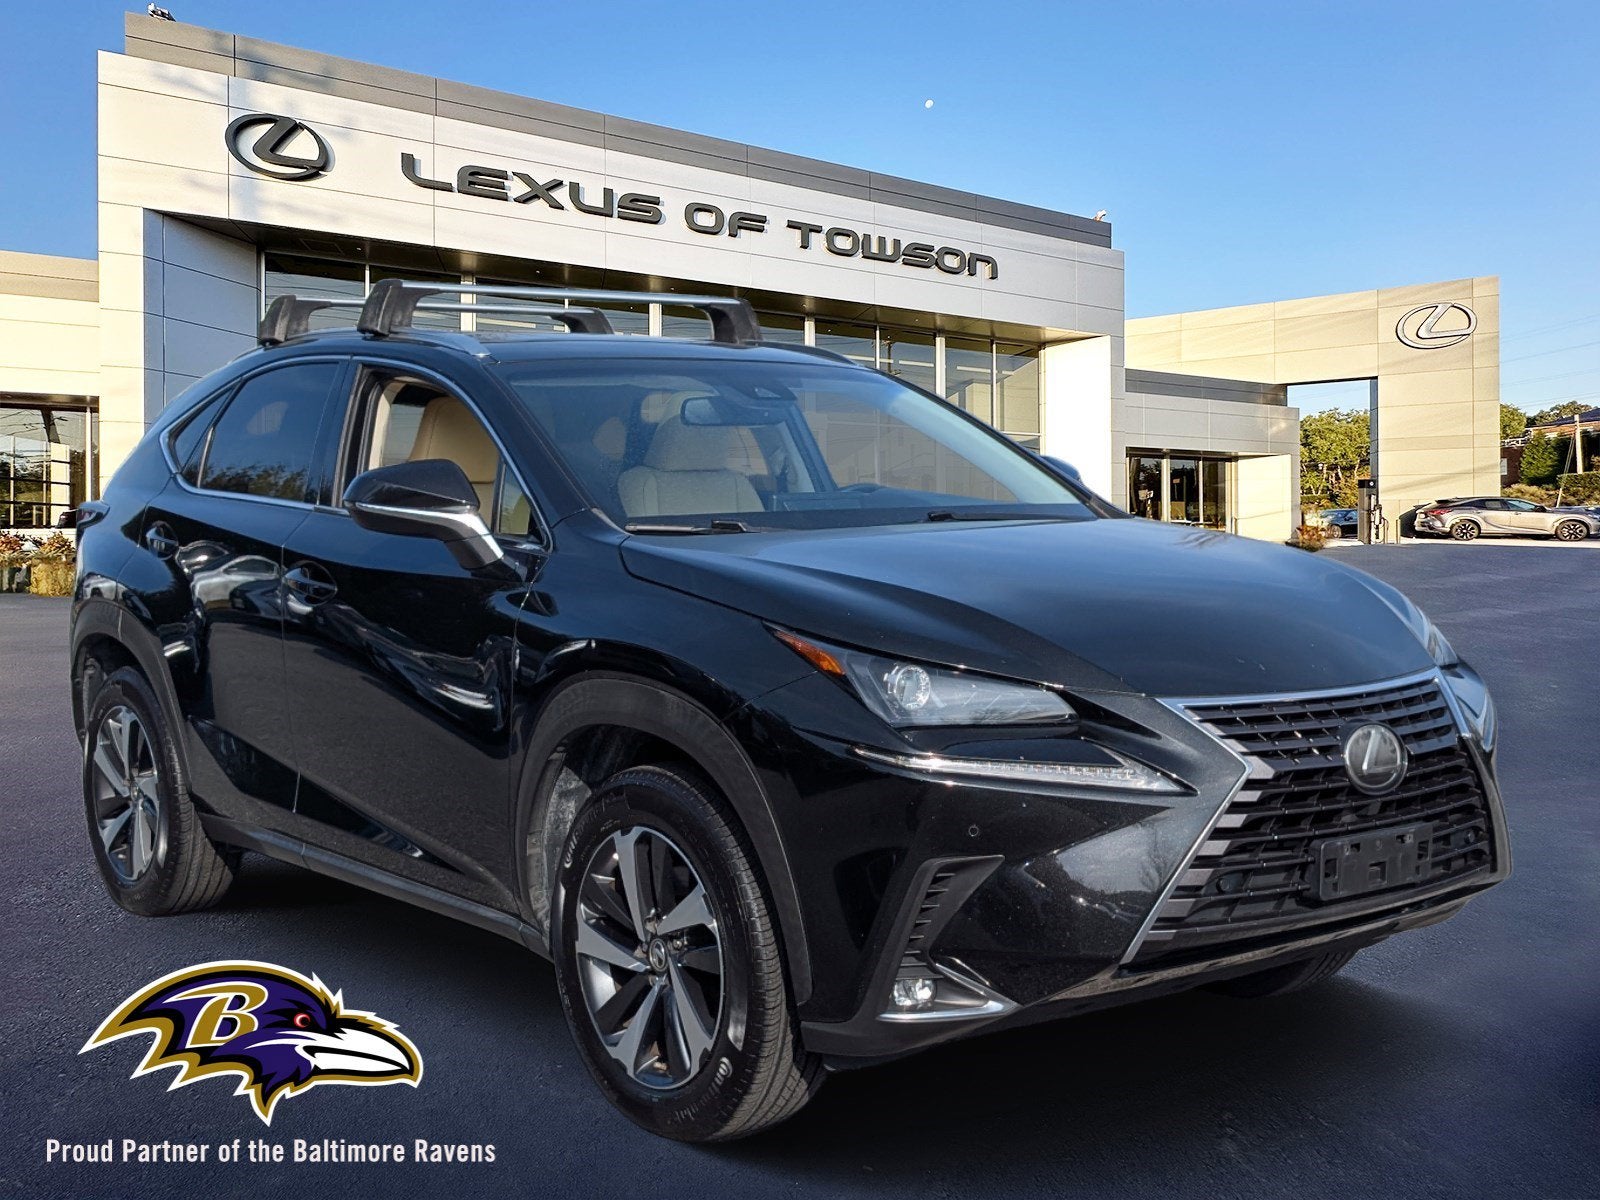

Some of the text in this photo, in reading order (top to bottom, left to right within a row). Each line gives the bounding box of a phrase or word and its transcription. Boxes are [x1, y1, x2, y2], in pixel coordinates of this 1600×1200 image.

[401, 153, 998, 280] LEXUS OF TOWSON
